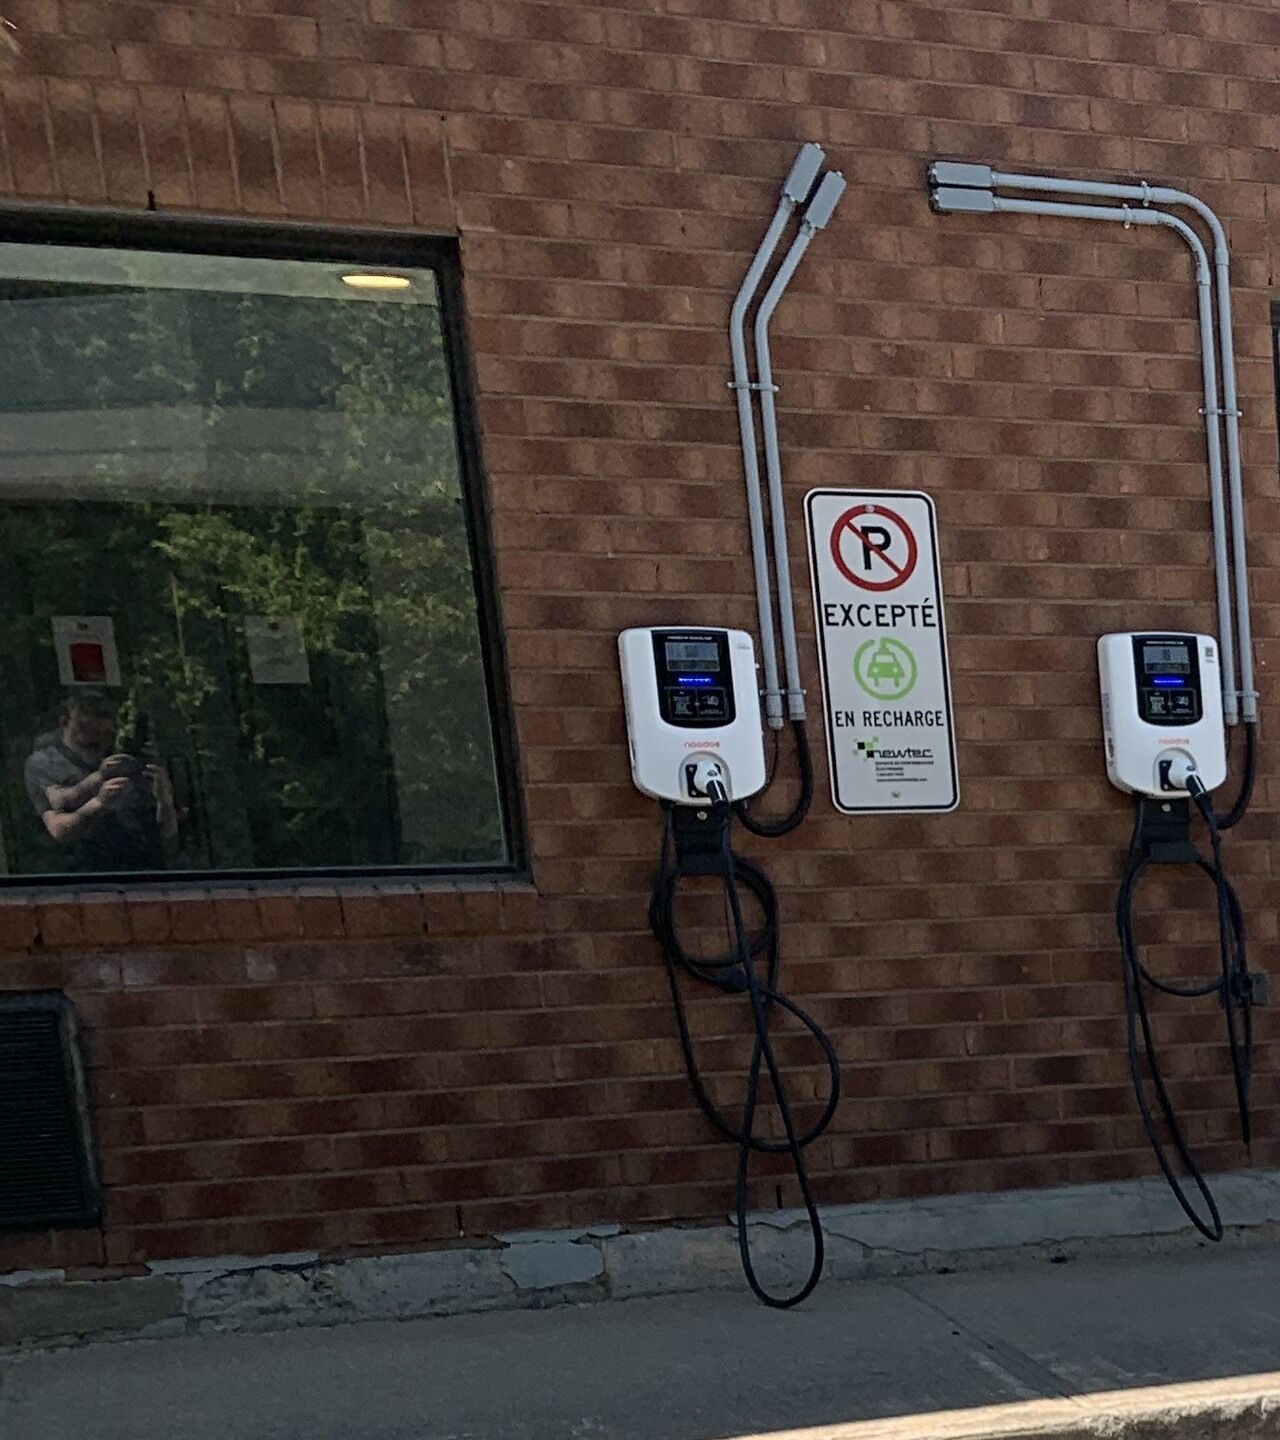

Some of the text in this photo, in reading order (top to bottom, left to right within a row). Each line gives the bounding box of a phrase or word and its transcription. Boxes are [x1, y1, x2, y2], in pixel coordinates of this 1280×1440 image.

[859, 525, 892, 571] P
[823, 597, 937, 628] EXCEPTÉ
[835, 709, 945, 728] EN RECHARGE
[873, 747, 934, 759] newtec
